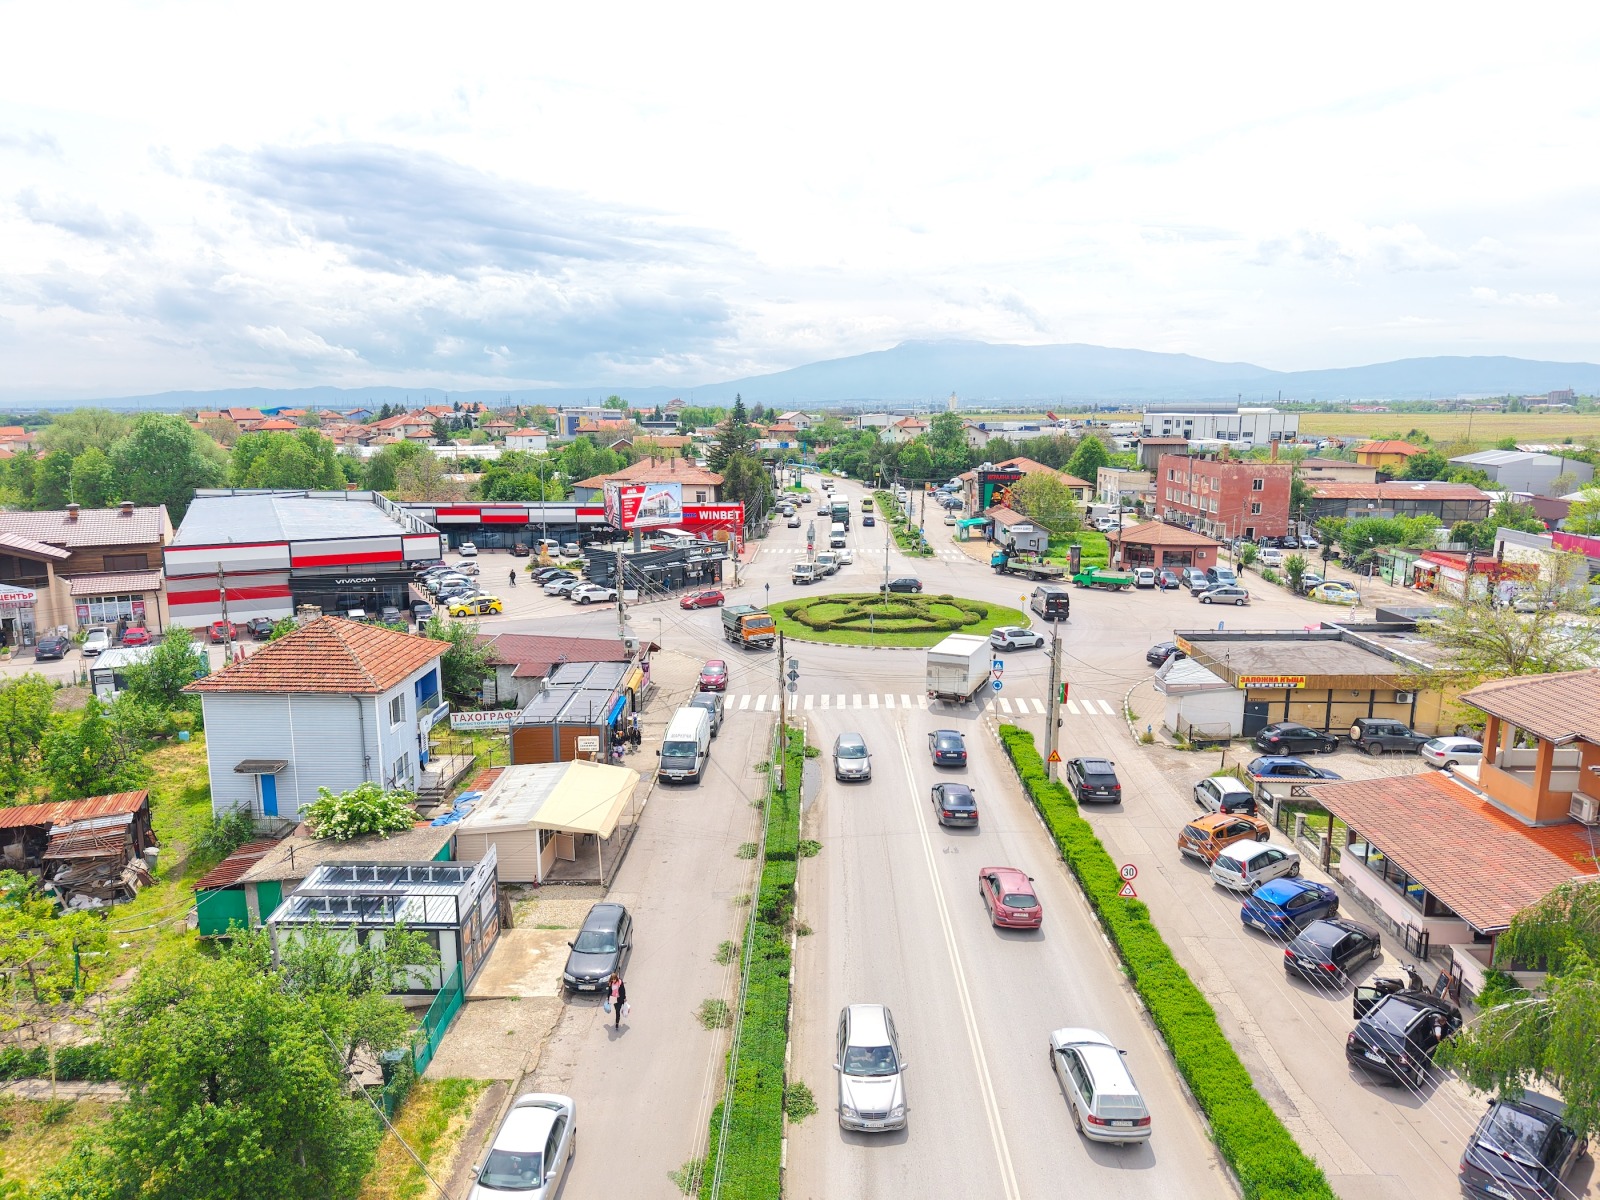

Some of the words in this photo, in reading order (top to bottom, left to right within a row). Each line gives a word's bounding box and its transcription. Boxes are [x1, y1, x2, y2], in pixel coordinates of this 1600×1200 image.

[699, 510, 740, 519] WINBET
[1280, 676, 1305, 684] КЪЩА
[1123, 867, 1134, 877] 30
